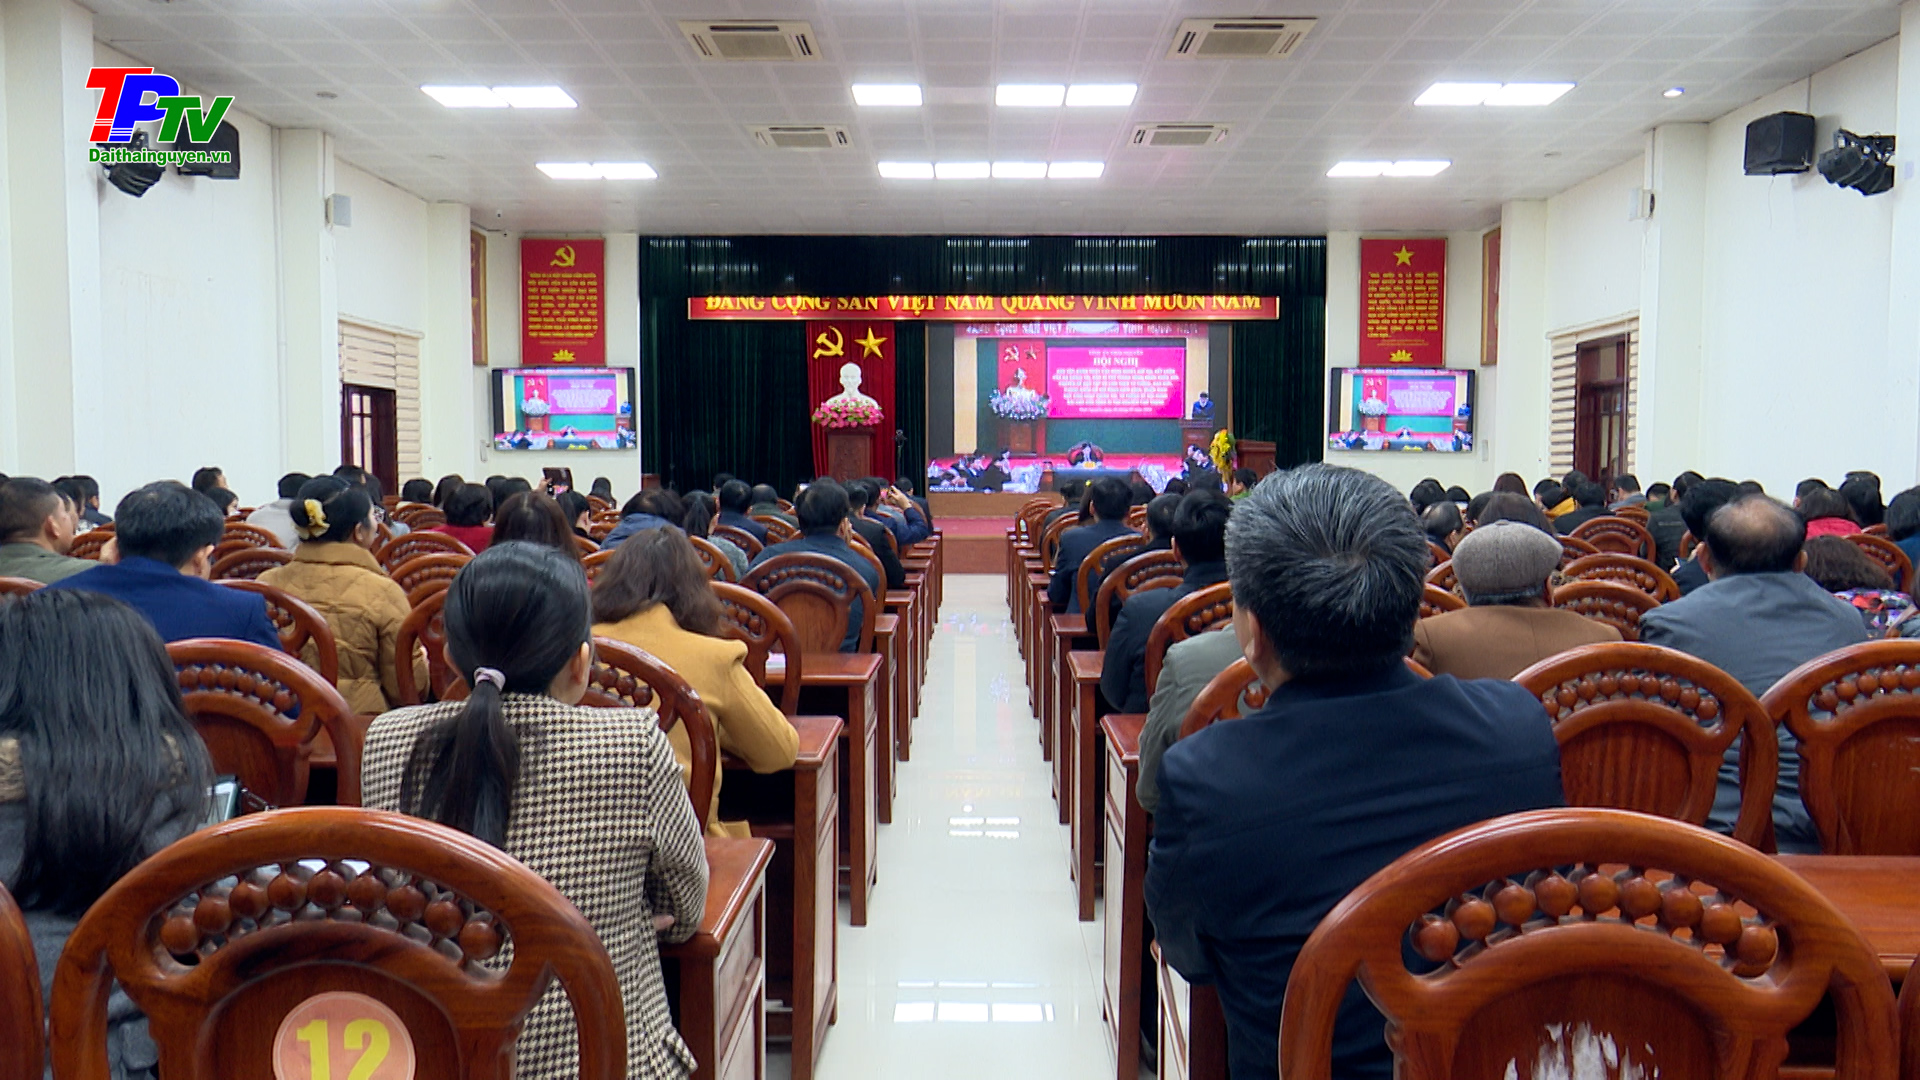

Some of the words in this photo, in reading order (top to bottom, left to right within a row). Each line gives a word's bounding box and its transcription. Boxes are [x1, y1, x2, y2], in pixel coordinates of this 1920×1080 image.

[944, 295, 994, 310] NAM
[1081, 295, 1137, 310] VINH
[296, 1018, 391, 1080] 12
